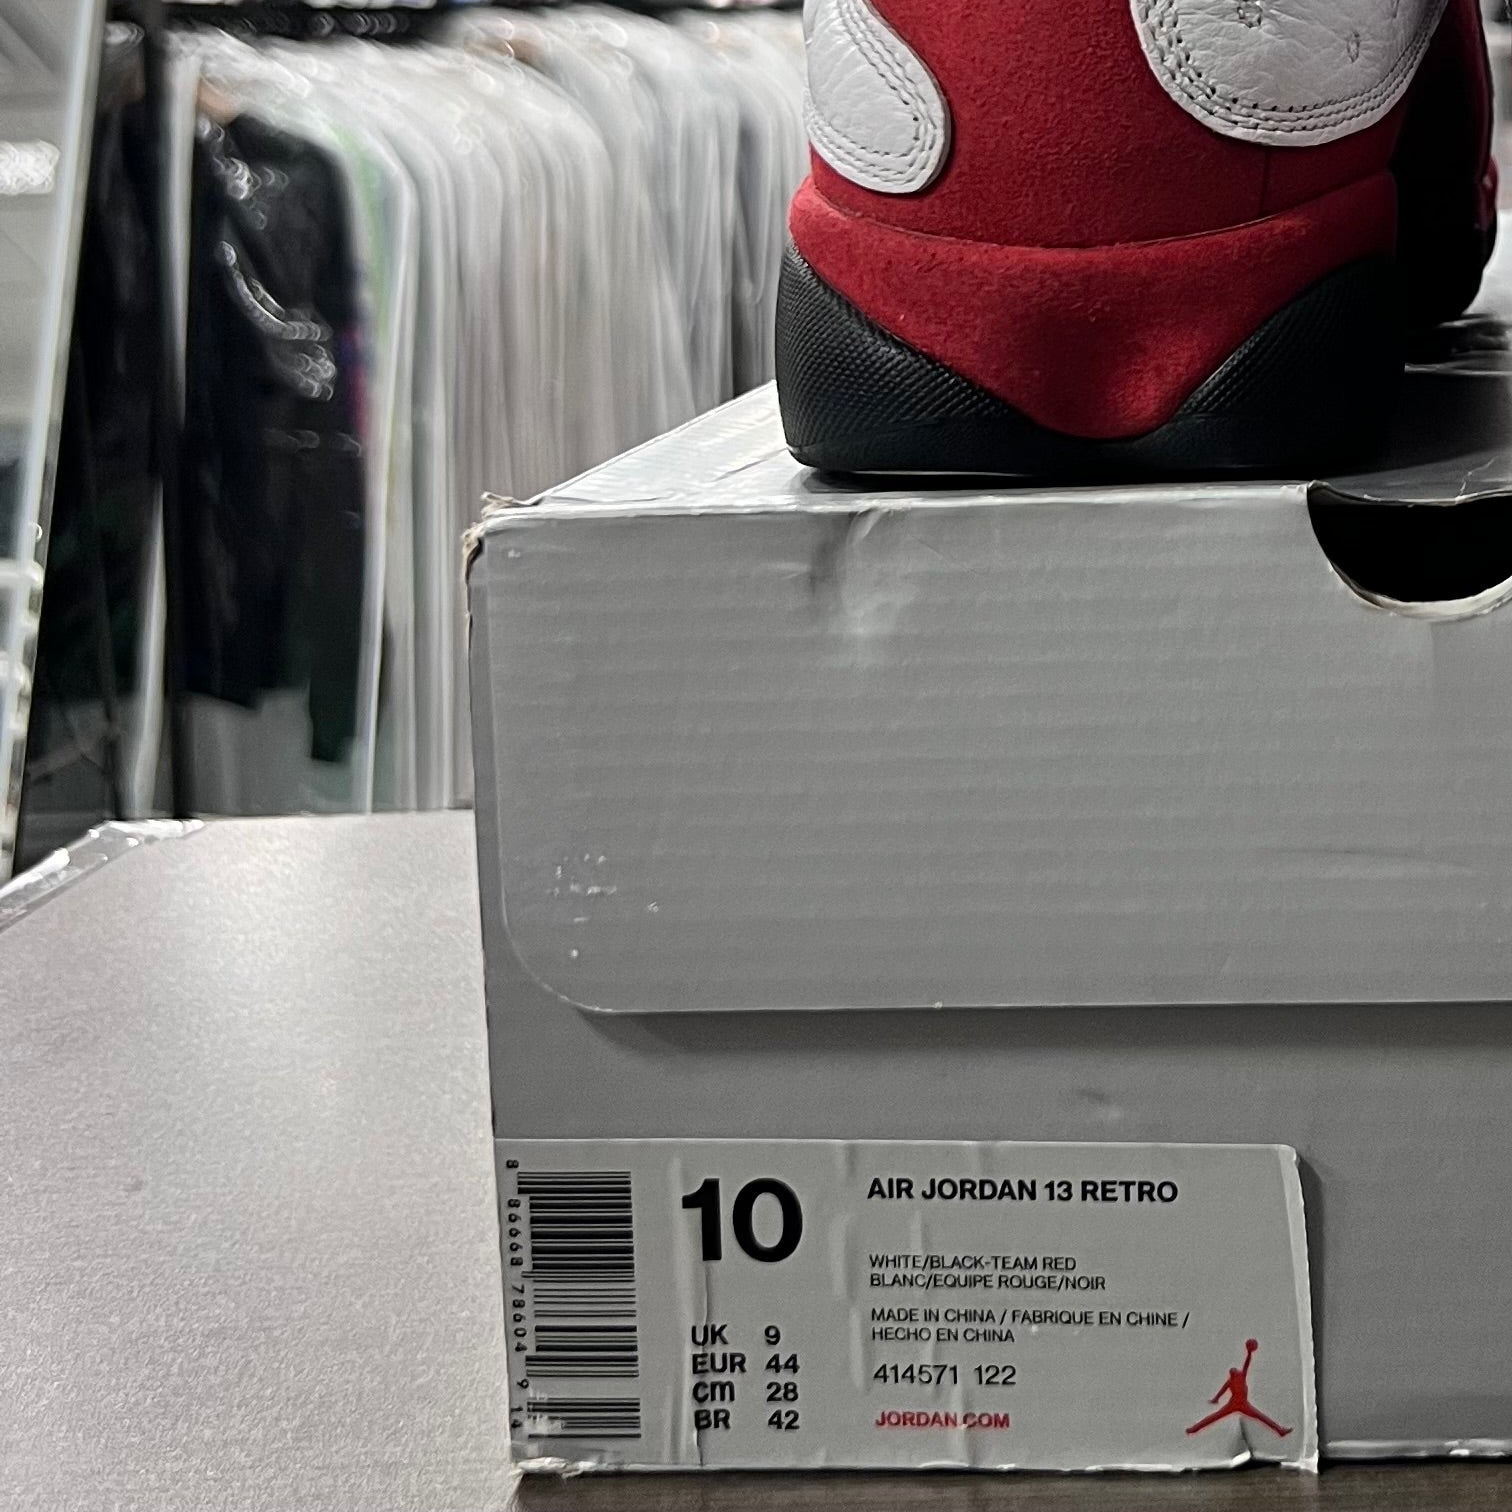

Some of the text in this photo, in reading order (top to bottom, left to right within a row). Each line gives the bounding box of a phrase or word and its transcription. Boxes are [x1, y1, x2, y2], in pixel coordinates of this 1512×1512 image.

[506, 1159, 519, 1169] 8
[867, 1178, 1178, 1202] AIR JORDAN 13 RETRO
[682, 1178, 803, 1262] 10
[869, 1254, 1076, 1271] WHITE/BLACK-TEAM RED
[870, 1273, 1106, 1291] BLANC/EQUIPE ROUGE/NOIR
[511, 1284, 528, 1353] 78604
[871, 1308, 1190, 1329] MADE IN CHINA / FABRIQUE EN CHINE /
[691, 1324, 781, 1346] UK 9
[872, 1327, 1015, 1342] HECHO EN CHINA
[691, 1352, 800, 1374] EUR 44
[873, 1364, 1016, 1385] 414571 122
[766, 1381, 799, 1402] 28
[694, 1408, 800, 1430] BR 42
[875, 1411, 1010, 1428] JORDANCOM
